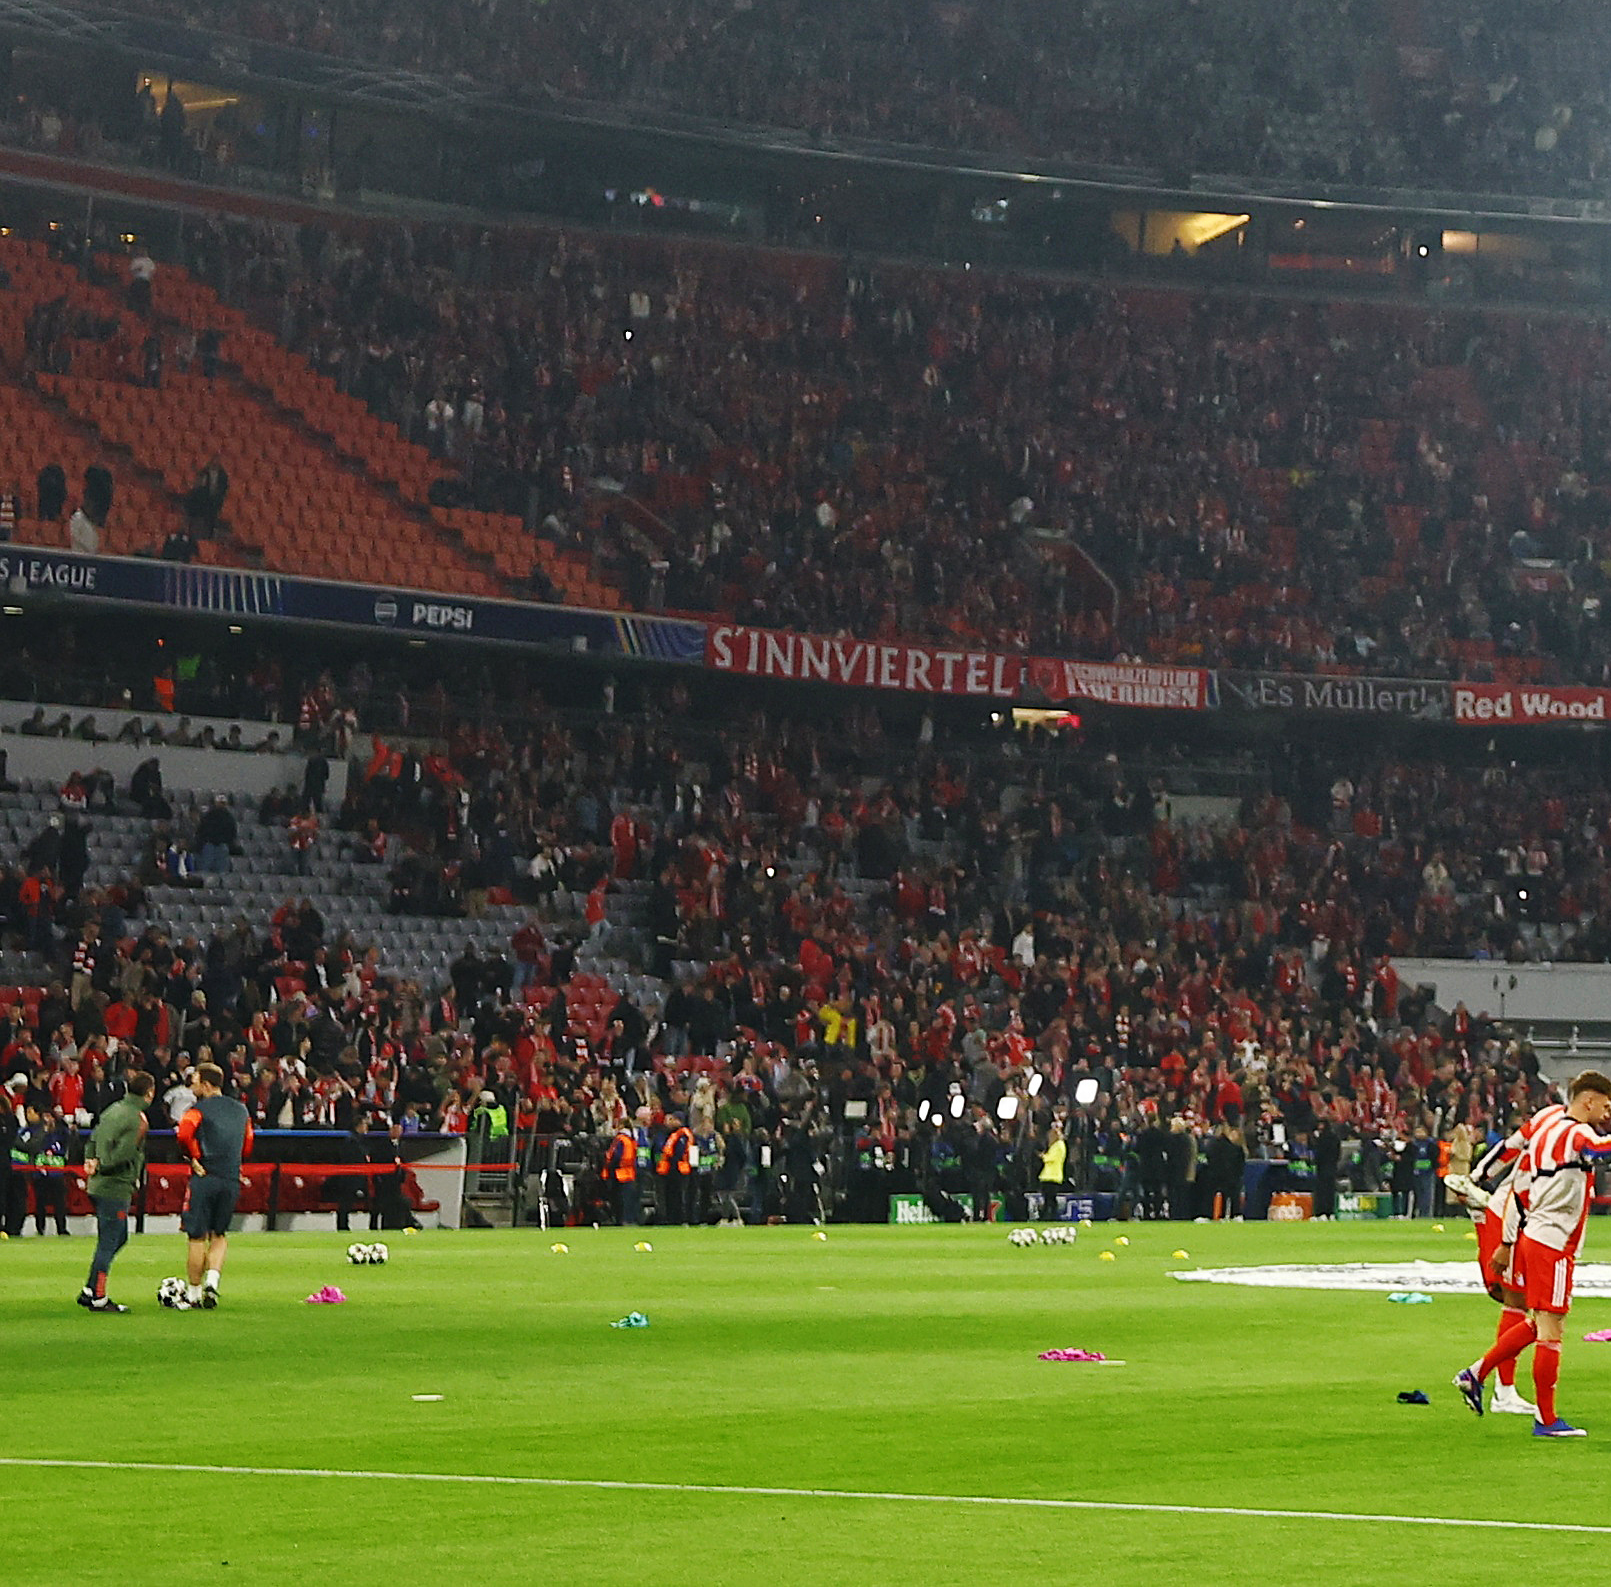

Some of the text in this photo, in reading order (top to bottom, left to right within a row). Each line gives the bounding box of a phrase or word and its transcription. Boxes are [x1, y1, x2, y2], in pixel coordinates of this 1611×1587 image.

[413, 602, 473, 630] PEPSI
[712, 626, 1014, 697] S'INNVIERTEL
[1258, 677, 1294, 708] Es
[1455, 689, 1512, 719] Red
[1520, 692, 1605, 719] Wood
